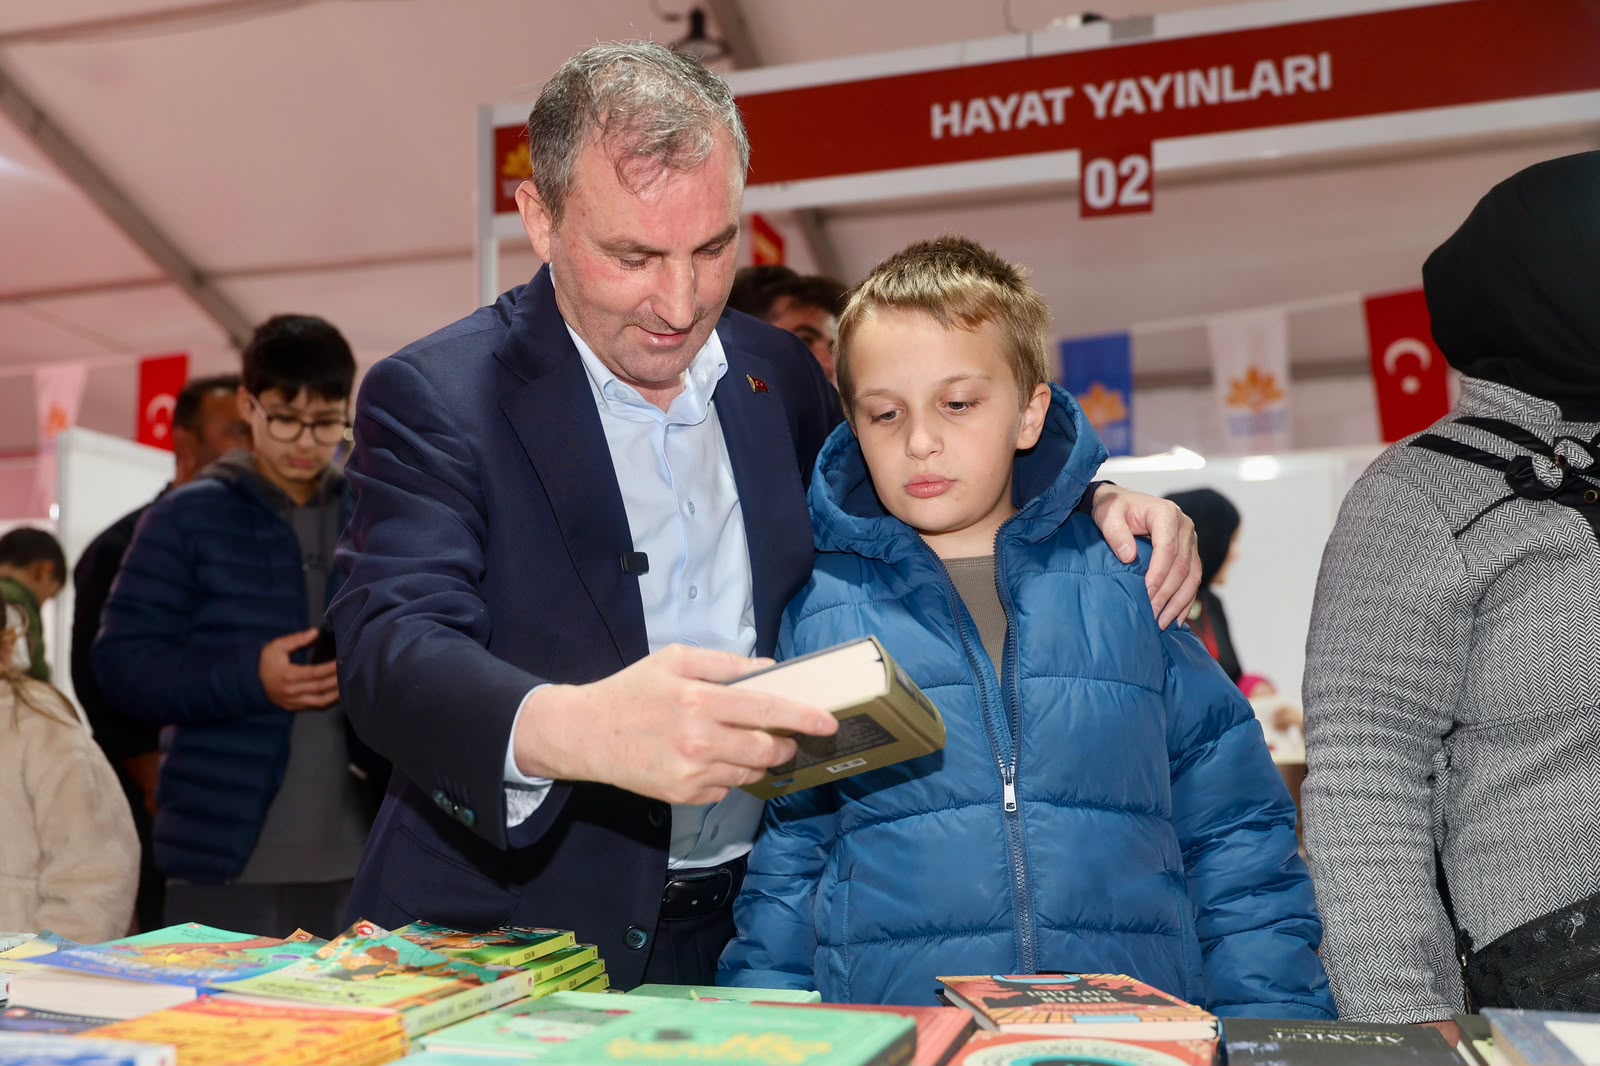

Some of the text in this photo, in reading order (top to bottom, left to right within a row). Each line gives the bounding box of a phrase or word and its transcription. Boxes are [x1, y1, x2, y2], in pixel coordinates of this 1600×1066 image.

[931, 52, 1332, 139] HAYAT YAYINLARI
[1085, 155, 1150, 209] 02
[1268, 1031, 1405, 1044] ALAMUT
